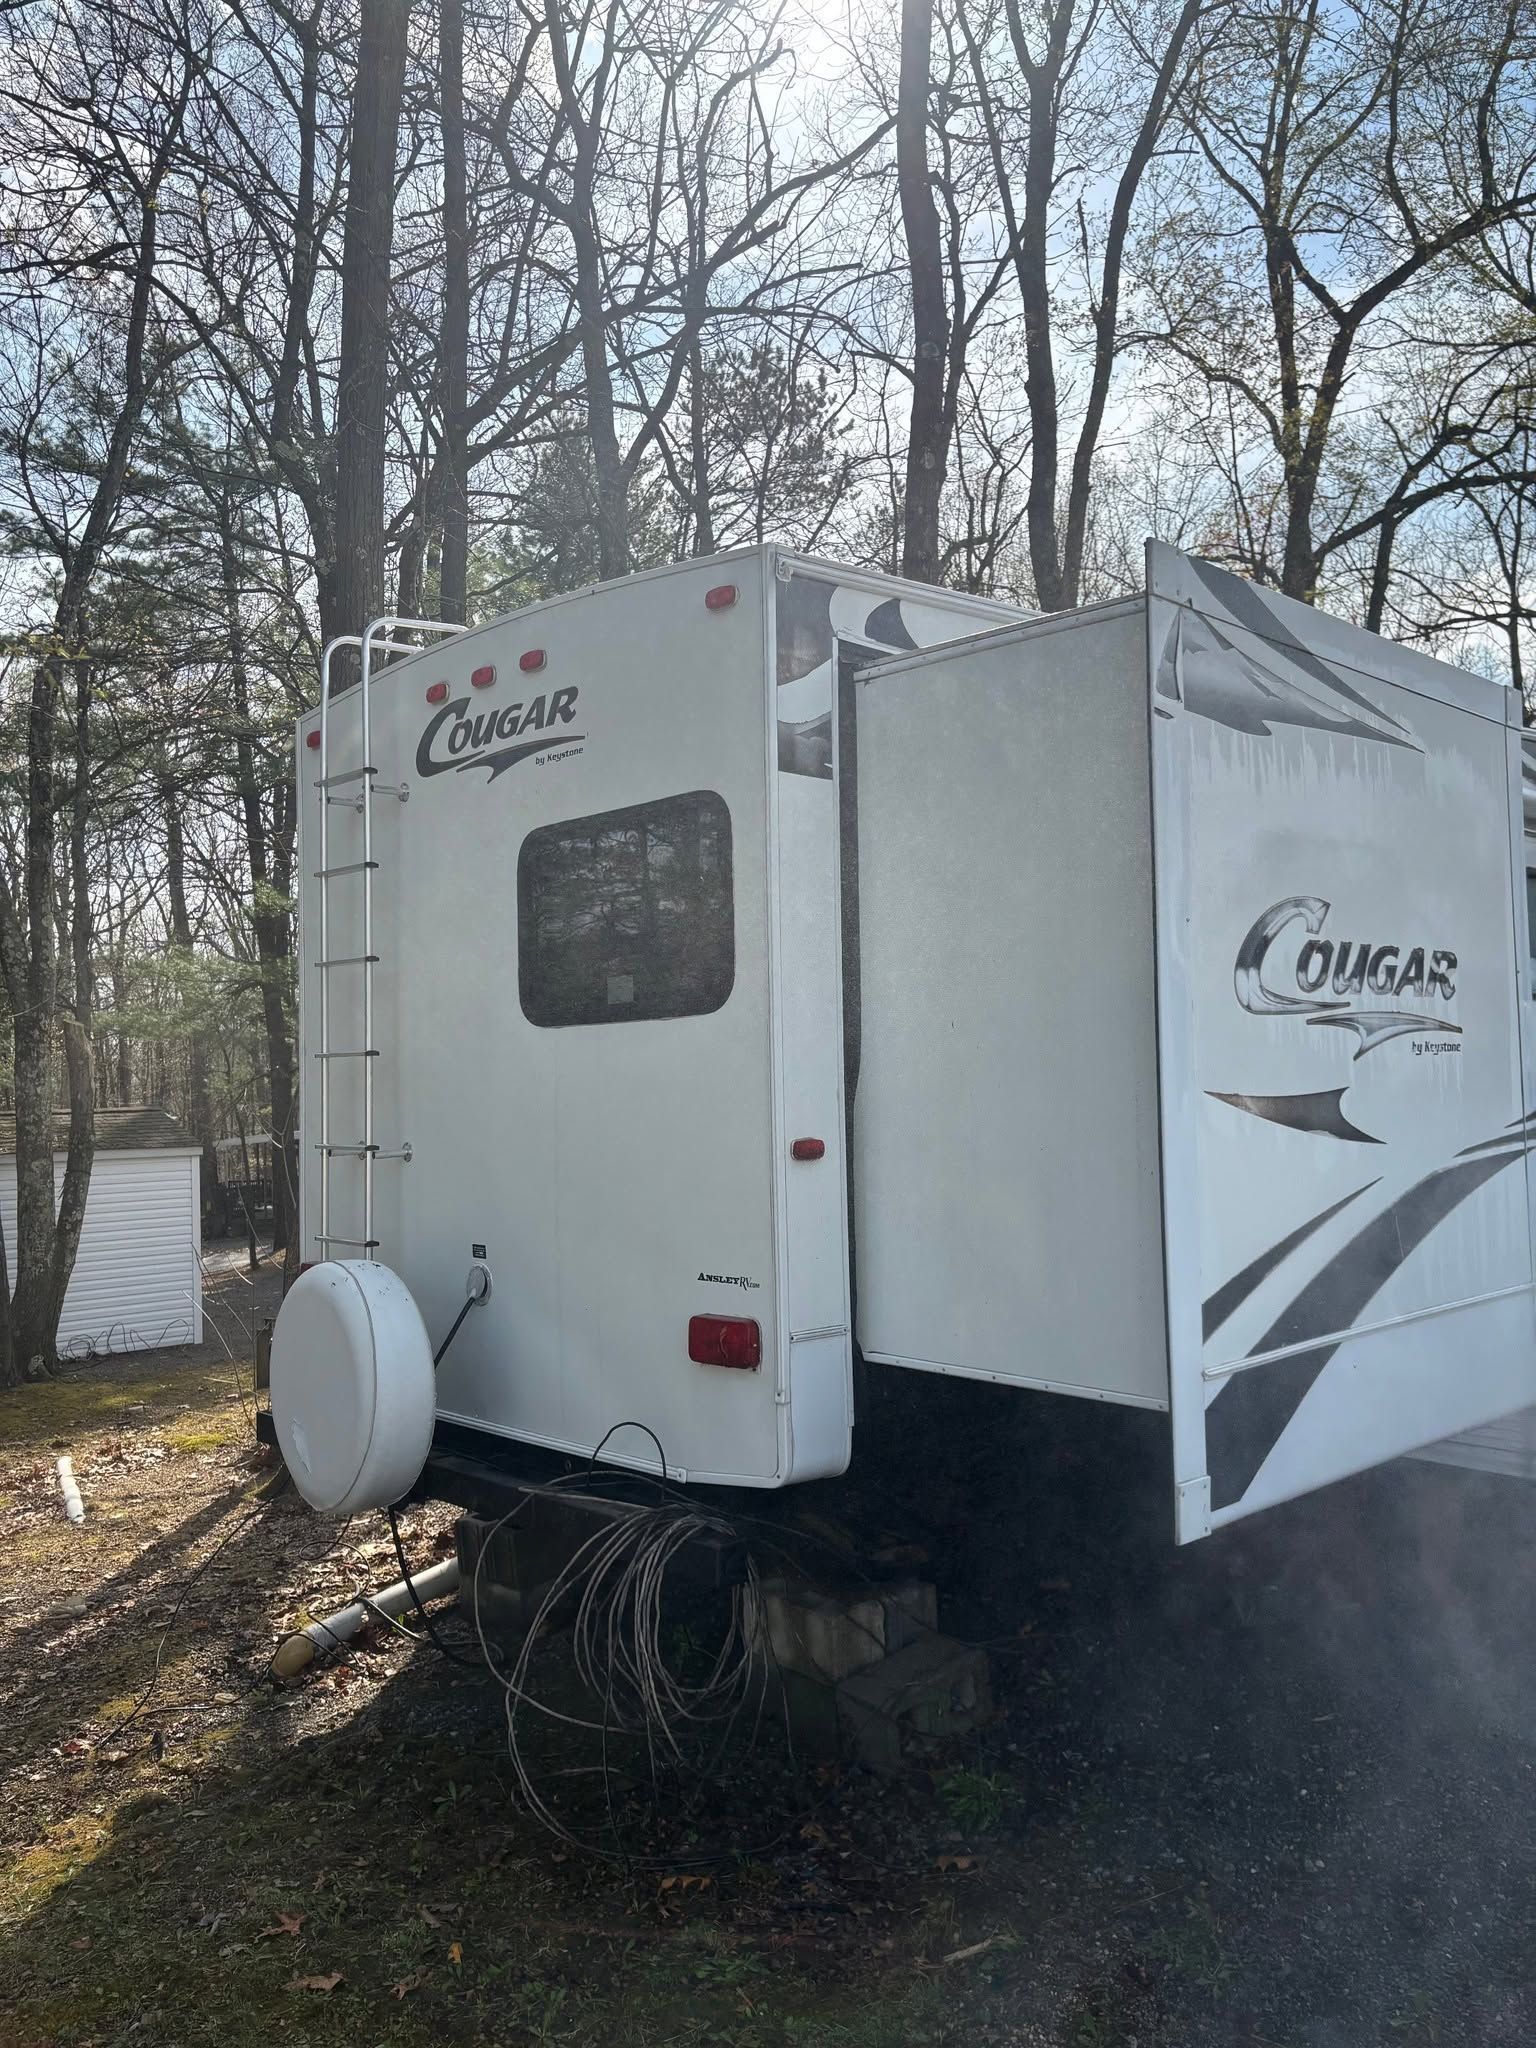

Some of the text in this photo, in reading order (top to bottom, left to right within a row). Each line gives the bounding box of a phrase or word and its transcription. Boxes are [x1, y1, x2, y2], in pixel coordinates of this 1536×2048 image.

[535, 747, 584, 766] by Keystone
[1411, 1041, 1462, 1056] by Keystone
